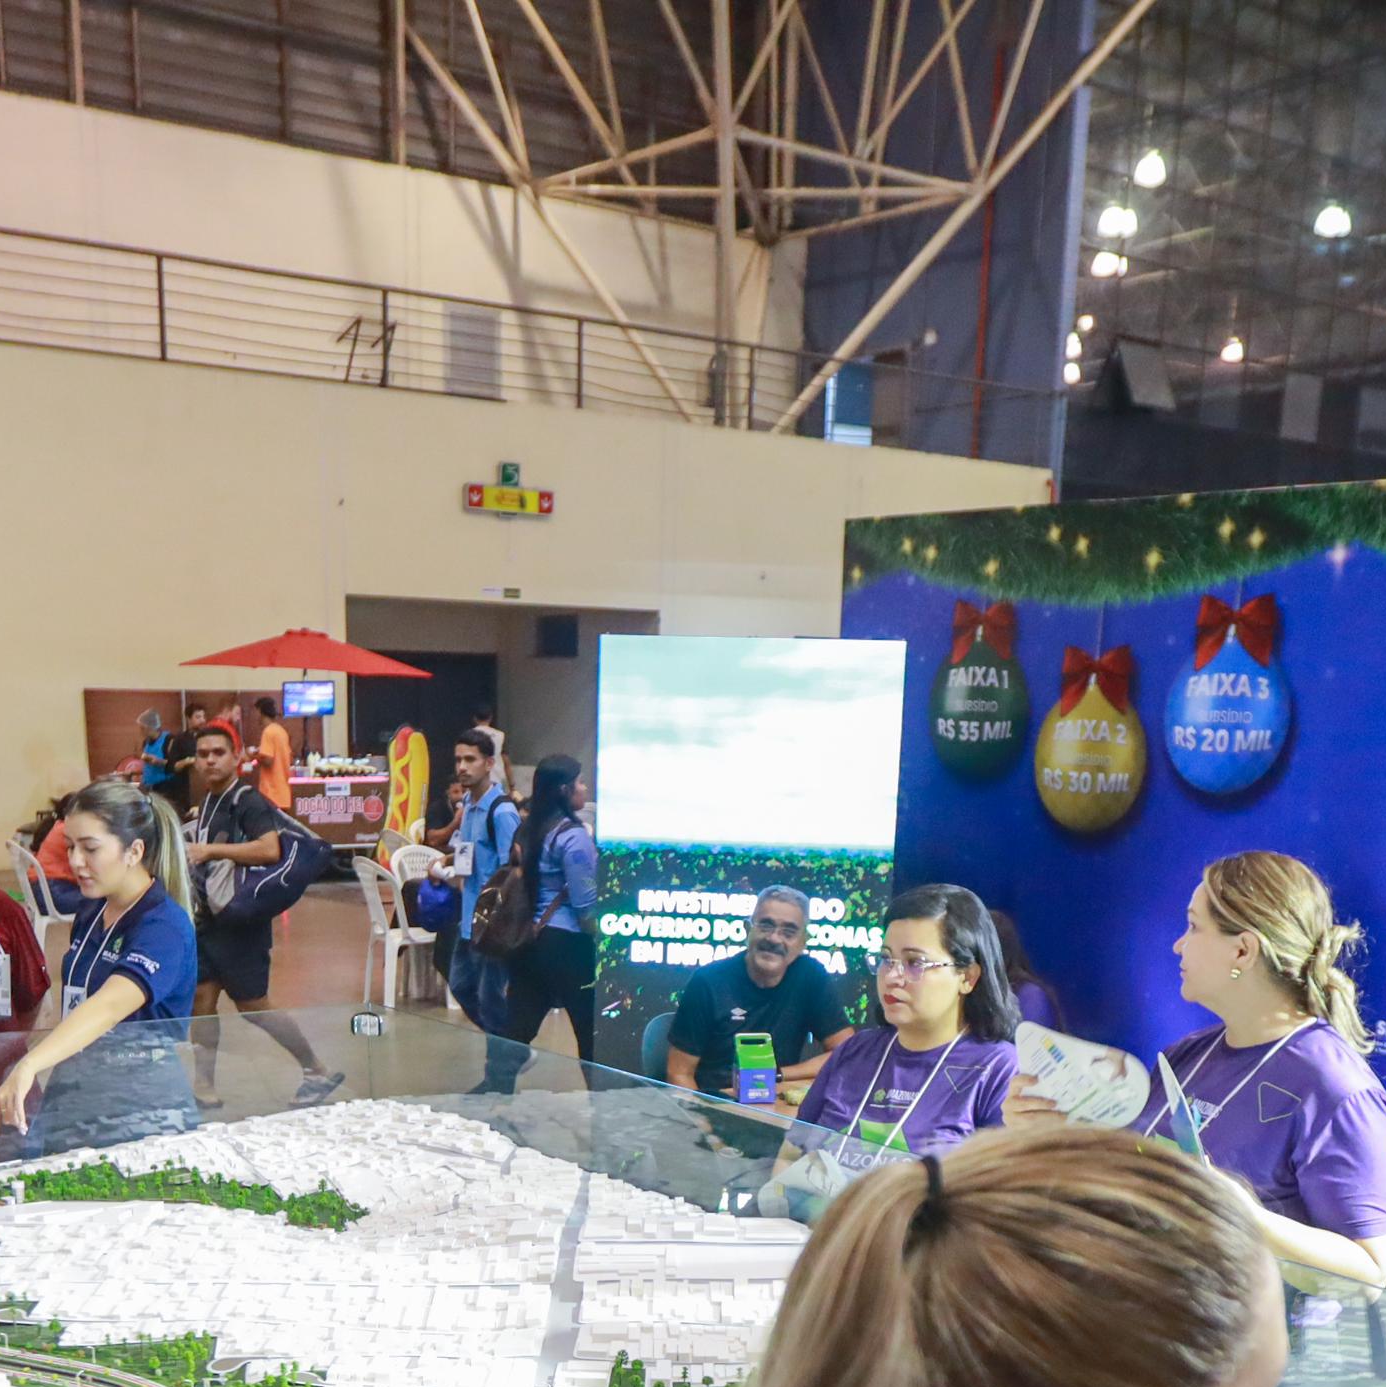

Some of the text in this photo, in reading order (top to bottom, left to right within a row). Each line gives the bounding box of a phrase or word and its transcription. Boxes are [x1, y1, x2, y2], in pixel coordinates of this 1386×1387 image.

[948, 666, 1009, 689] FAIXA 1
[1186, 672, 1270, 700] FAIXA 3
[938, 717, 1012, 741] R$ 35 MIL
[1116, 723, 1127, 745] 2
[1173, 724, 1272, 753] R$ 20 MIL
[1043, 767, 1130, 794] R$ 30 MIL
[808, 897, 846, 922] DO
[600, 914, 711, 941] GOVERNO
[712, 918, 747, 942] DO
[630, 940, 663, 963] EM
